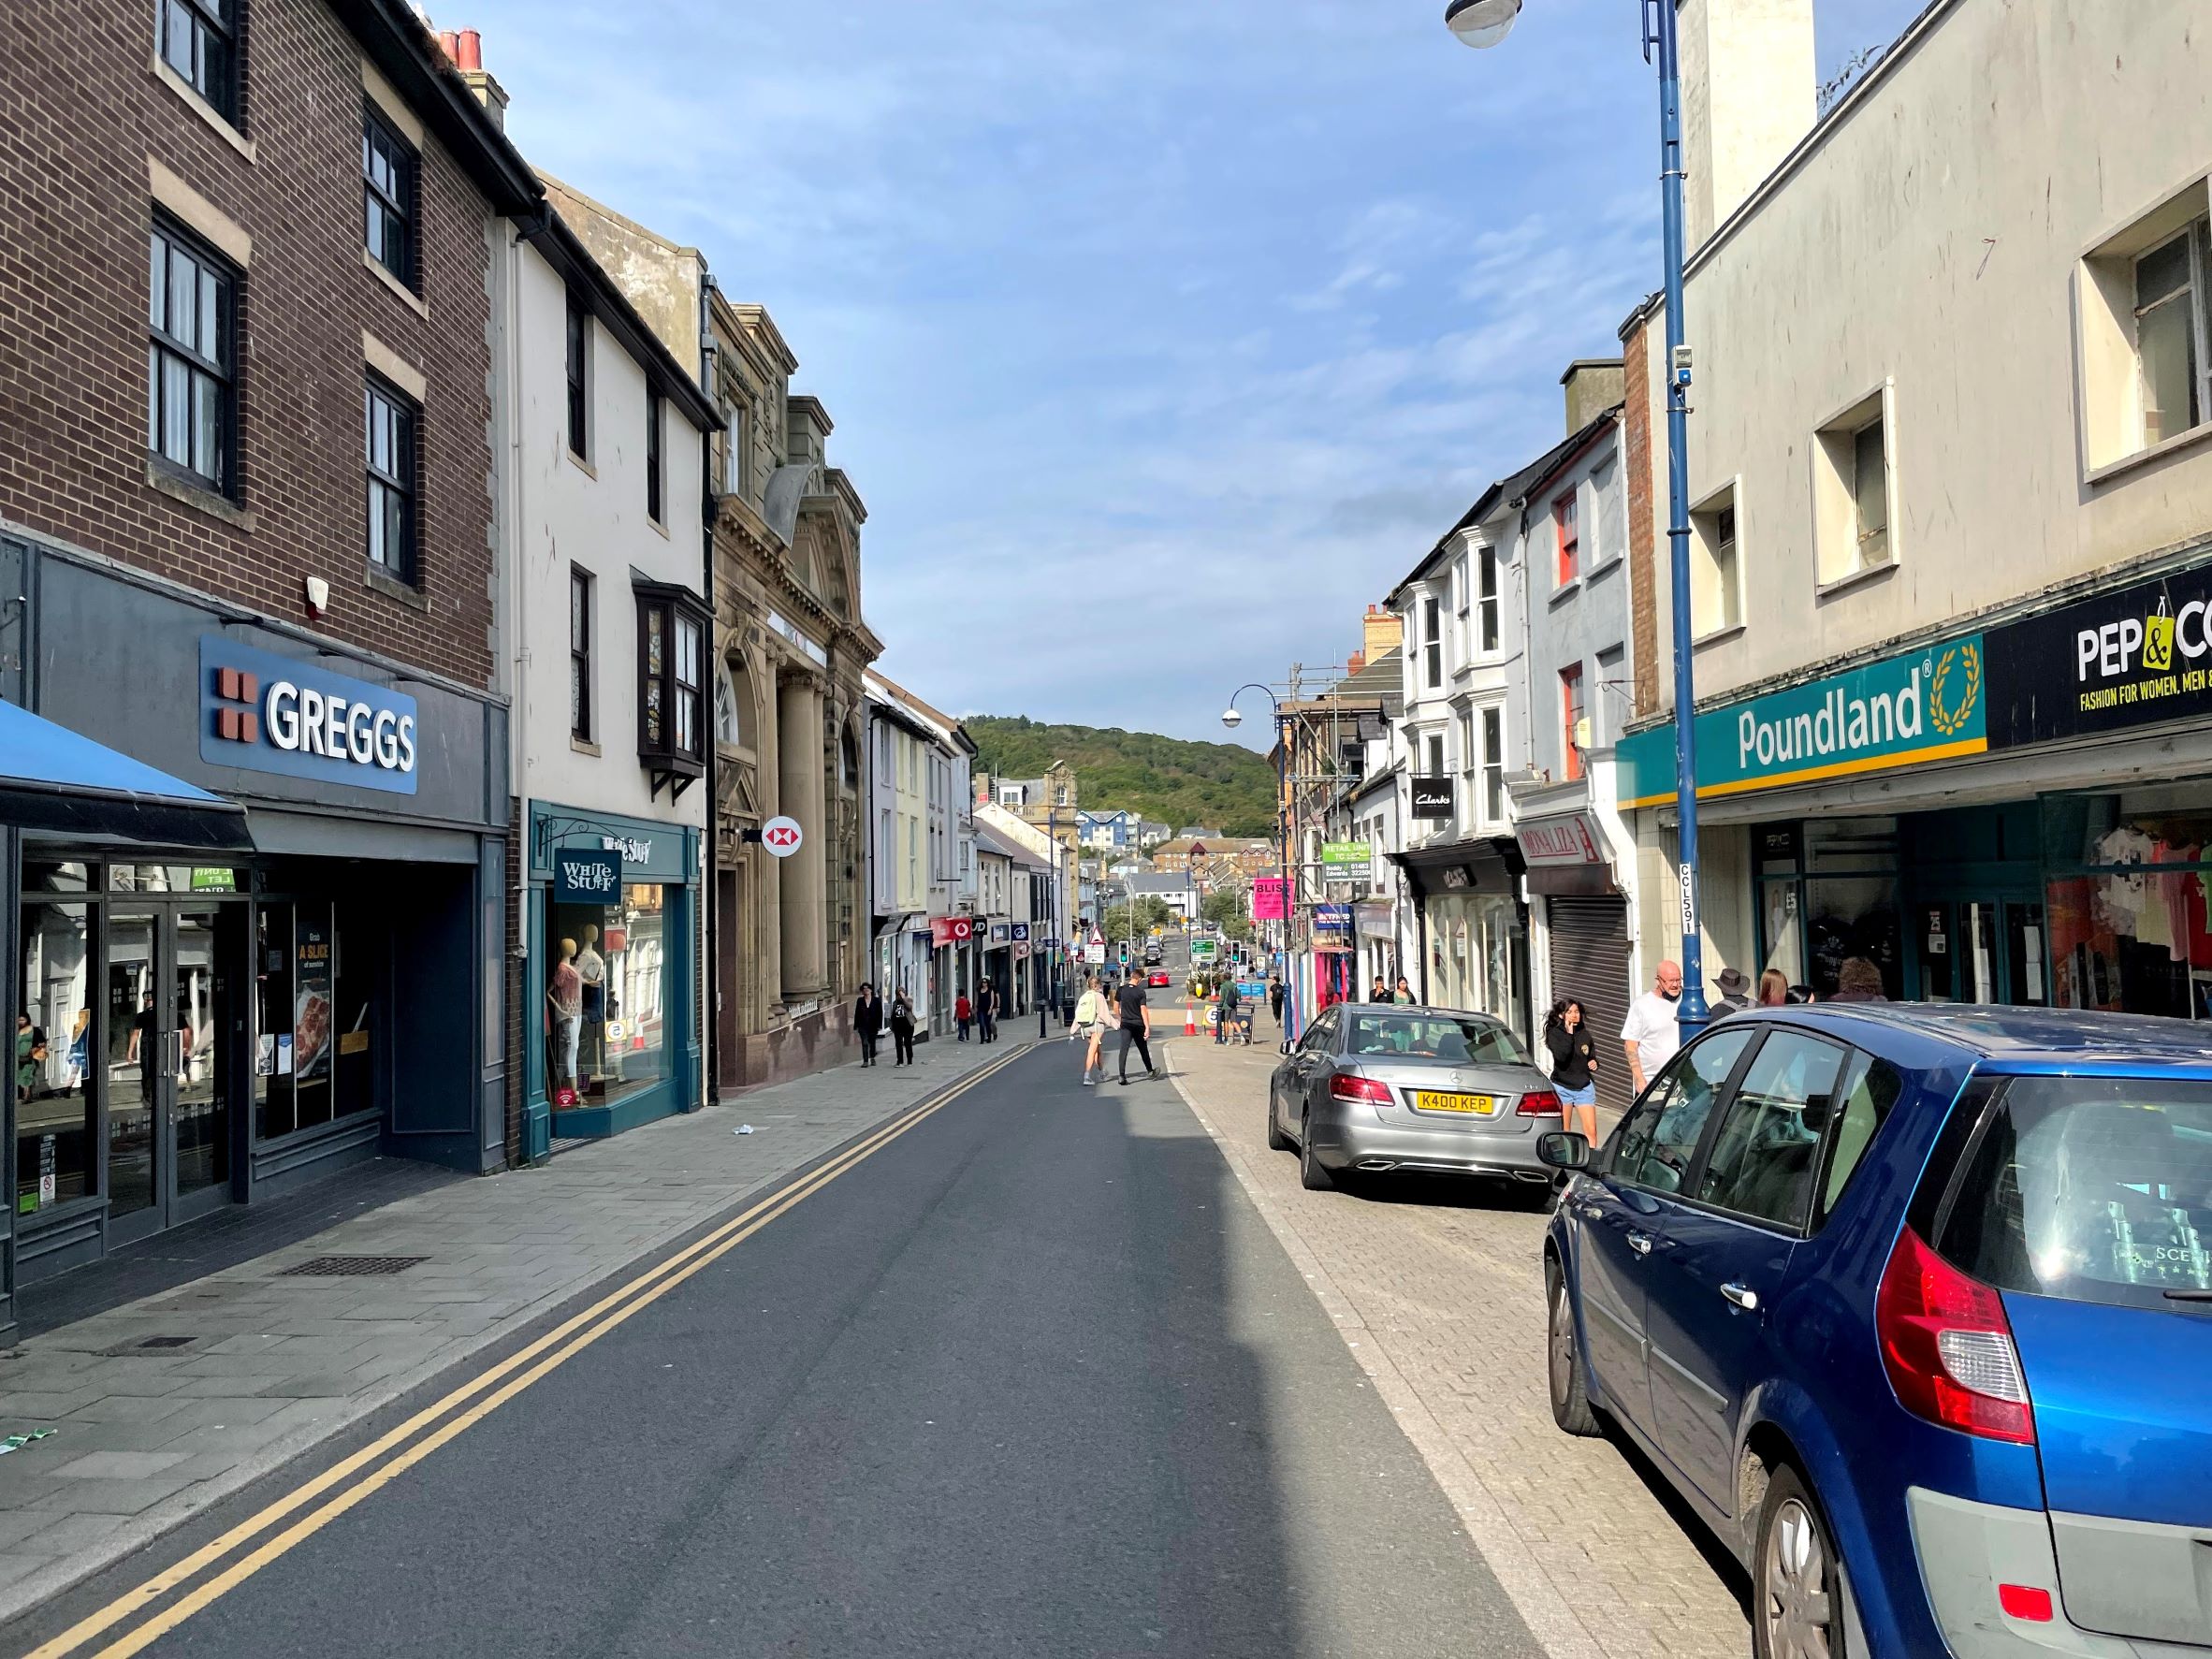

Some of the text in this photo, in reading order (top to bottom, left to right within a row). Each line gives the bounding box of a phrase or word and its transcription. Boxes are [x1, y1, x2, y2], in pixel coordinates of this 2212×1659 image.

[2078, 618, 2143, 682] PEP
[2080, 688, 2117, 712] FASHION
[2119, 684, 2138, 705] FOR
[2139, 676, 2181, 701] WOMEN,
[2182, 669, 2205, 692] MEN
[267, 681, 415, 773] GREGGS
[1416, 794, 1450, 805] Clarks
[973, 922, 986, 932] JD
[299, 944, 329, 959] A SLICE
[1422, 1095, 1487, 1110] K400 KEP
